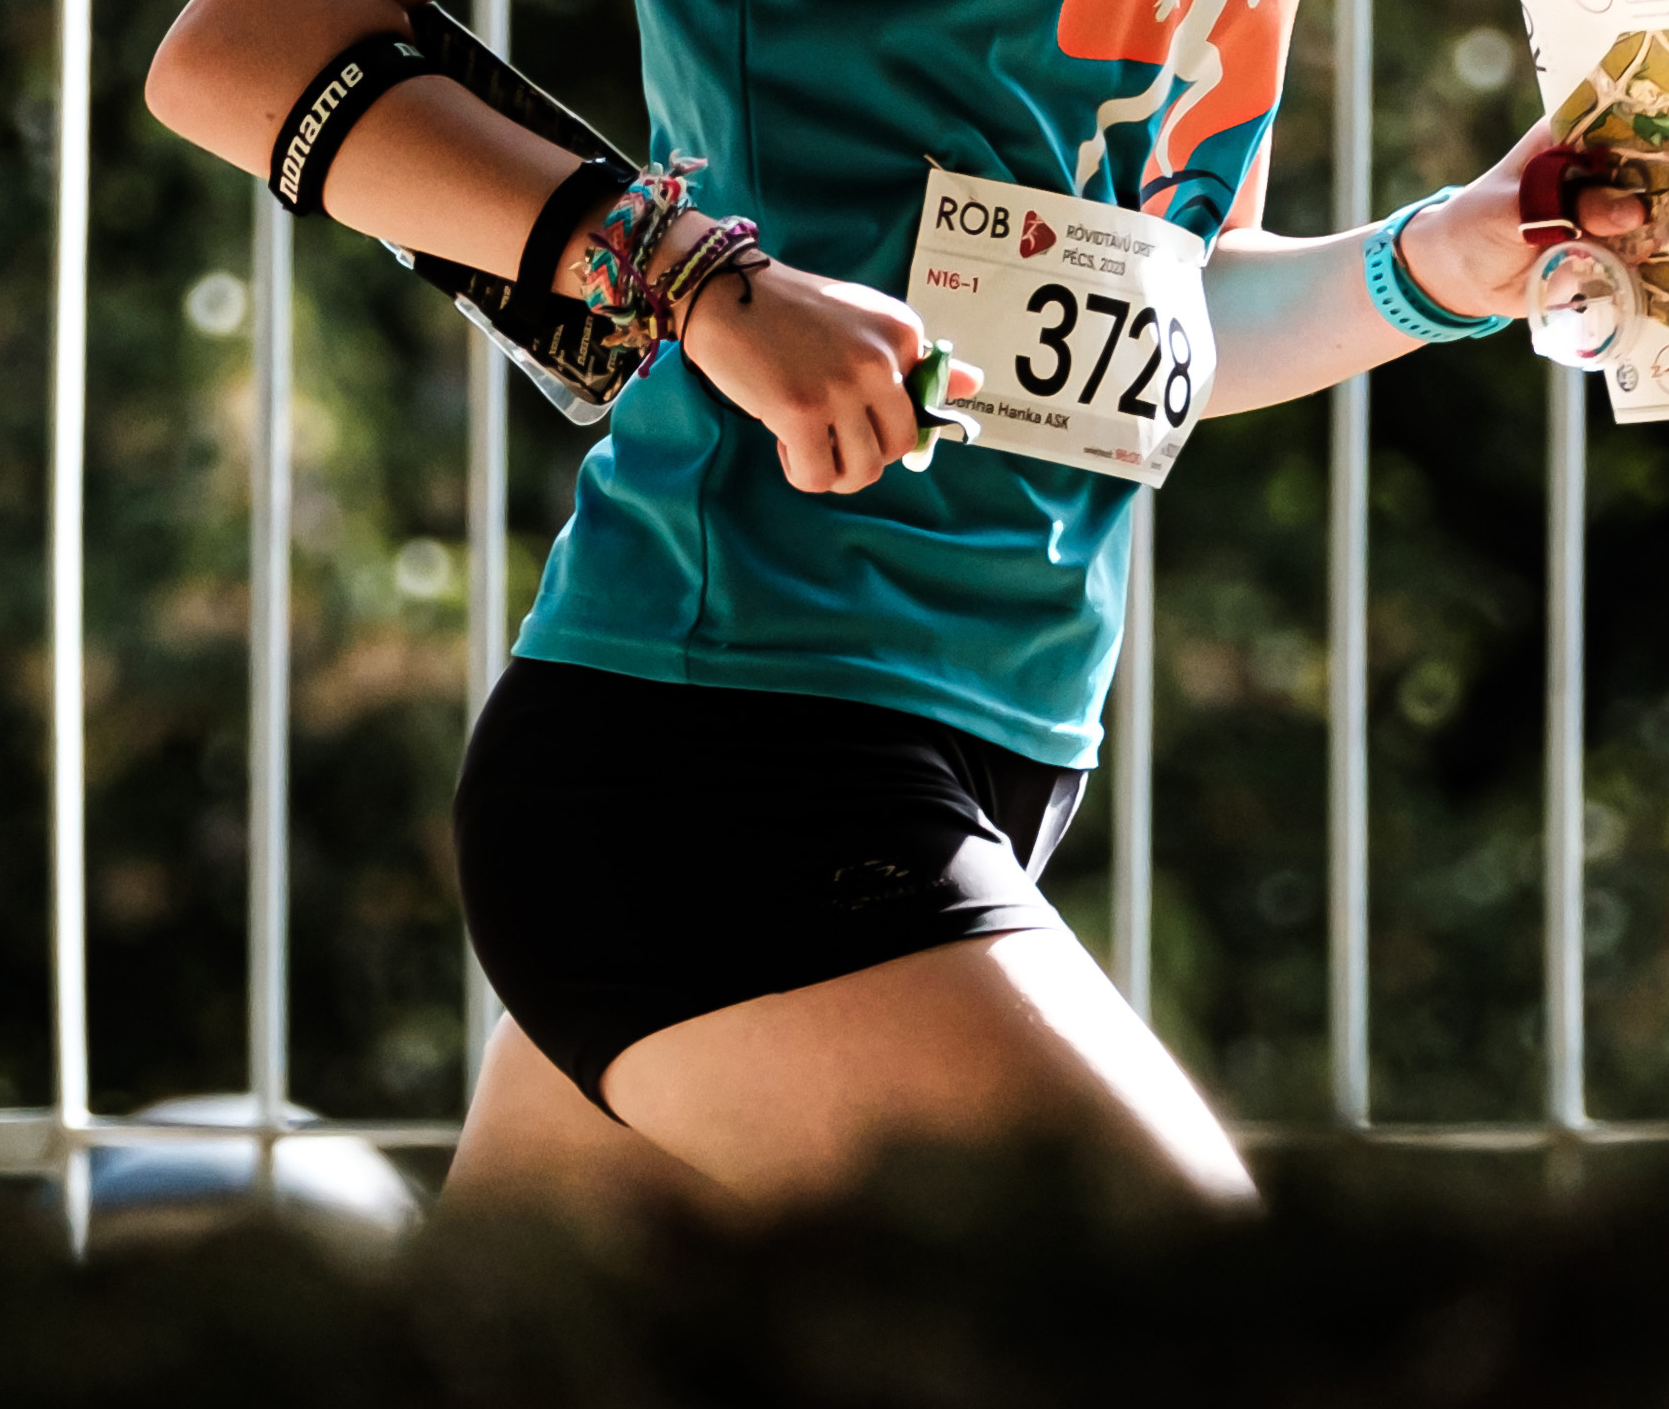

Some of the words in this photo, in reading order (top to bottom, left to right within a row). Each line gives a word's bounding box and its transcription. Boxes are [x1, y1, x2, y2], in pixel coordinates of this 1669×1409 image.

[280, 63, 364, 204] noname
[936, 196, 1010, 238] ROB
[926, 268, 979, 293] N16-1
[1015, 283, 1192, 428] 3728
[998, 401, 1042, 424] Hanka
